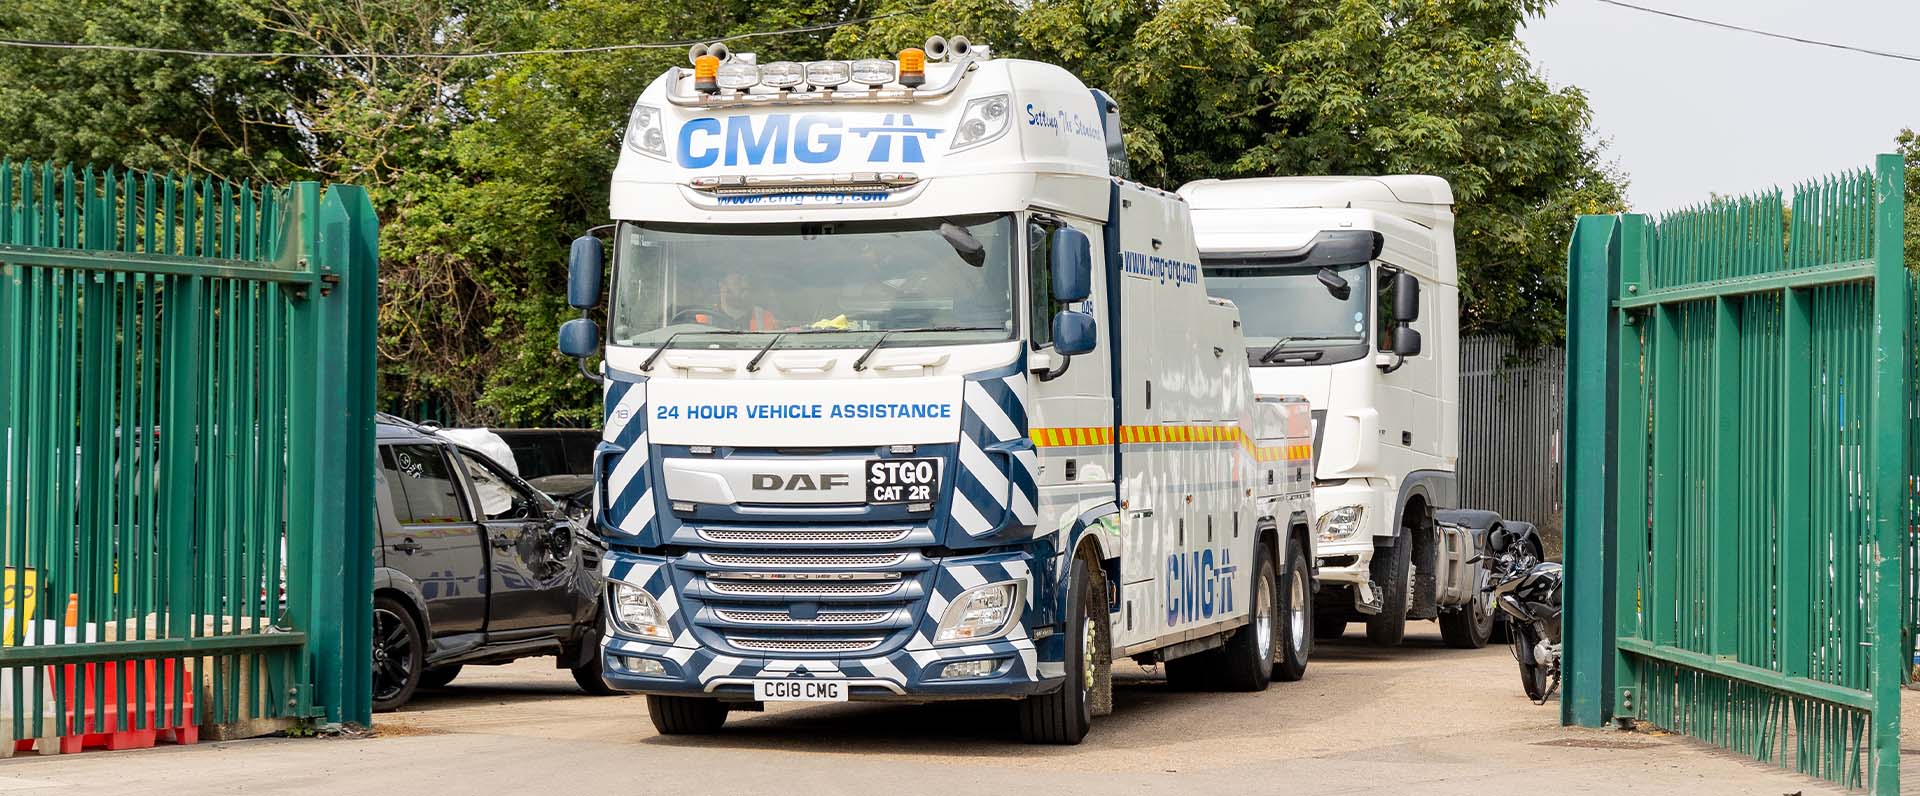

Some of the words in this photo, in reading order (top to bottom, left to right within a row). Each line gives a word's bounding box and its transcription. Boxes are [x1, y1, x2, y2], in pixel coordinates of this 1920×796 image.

[1026, 103, 1059, 137] Setting
[677, 114, 844, 170] CMG
[1124, 250, 1198, 288] www.cmg-org.com
[657, 405, 679, 420] 24
[687, 405, 738, 419] HOUR
[746, 404, 823, 419] VEHICLE
[830, 403, 951, 418] ASSISTANCE
[751, 473, 849, 491] DAF
[870, 461, 933, 485] STGO
[873, 486, 903, 501] CAT
[908, 485, 931, 500] 2R
[1166, 548, 1214, 628] CMG
[764, 682, 801, 698] CG18
[806, 683, 838, 698] CMG
